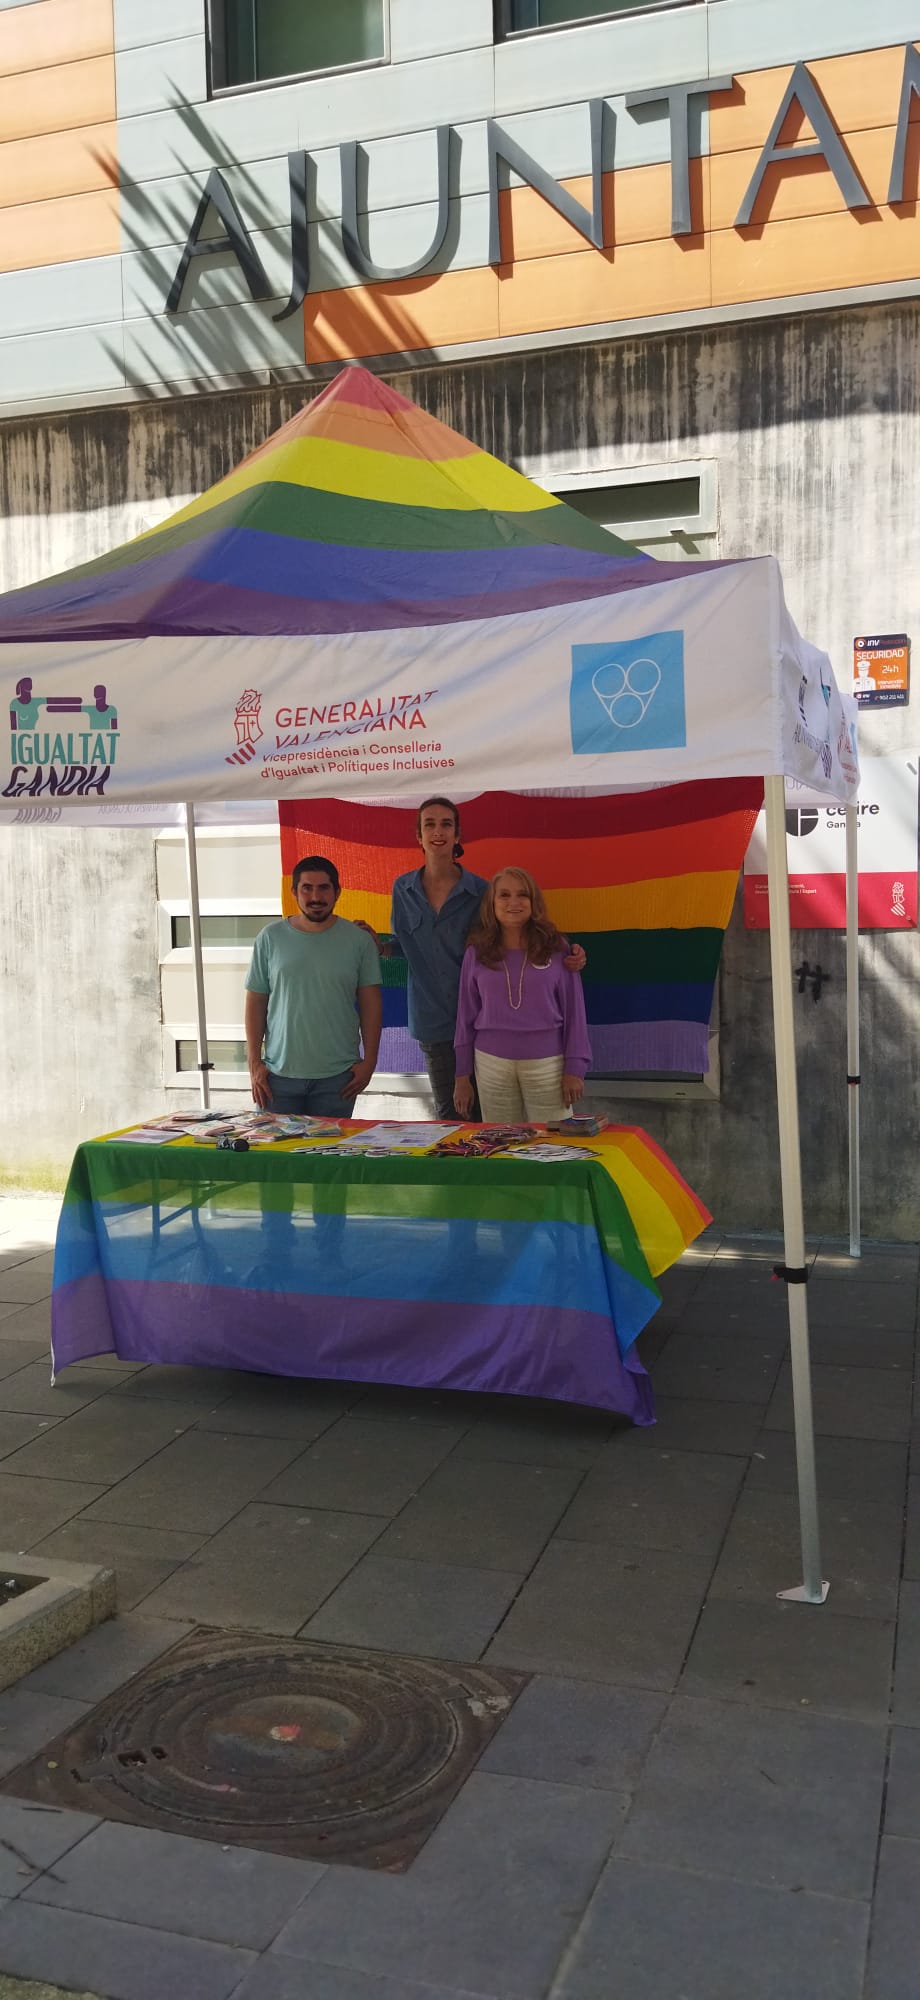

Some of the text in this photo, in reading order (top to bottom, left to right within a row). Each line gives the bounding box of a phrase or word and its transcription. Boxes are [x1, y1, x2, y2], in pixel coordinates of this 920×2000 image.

[856, 649, 905, 661] SEGURIDAD
[275, 689, 439, 728] GENERALITAT
[275, 708, 427, 749] VALENCIANA
[11, 732, 120, 765] IGUALTAT
[369, 740, 442, 755] Conselleria
[261, 764, 320, 780] d'Igualtat
[328, 760, 390, 775] Polítiques
[393, 757, 455, 771] Inclusives
[1, 765, 111, 797] GANDIA
[826, 801, 880, 816] ceire
[826, 820, 861, 829] Gana
